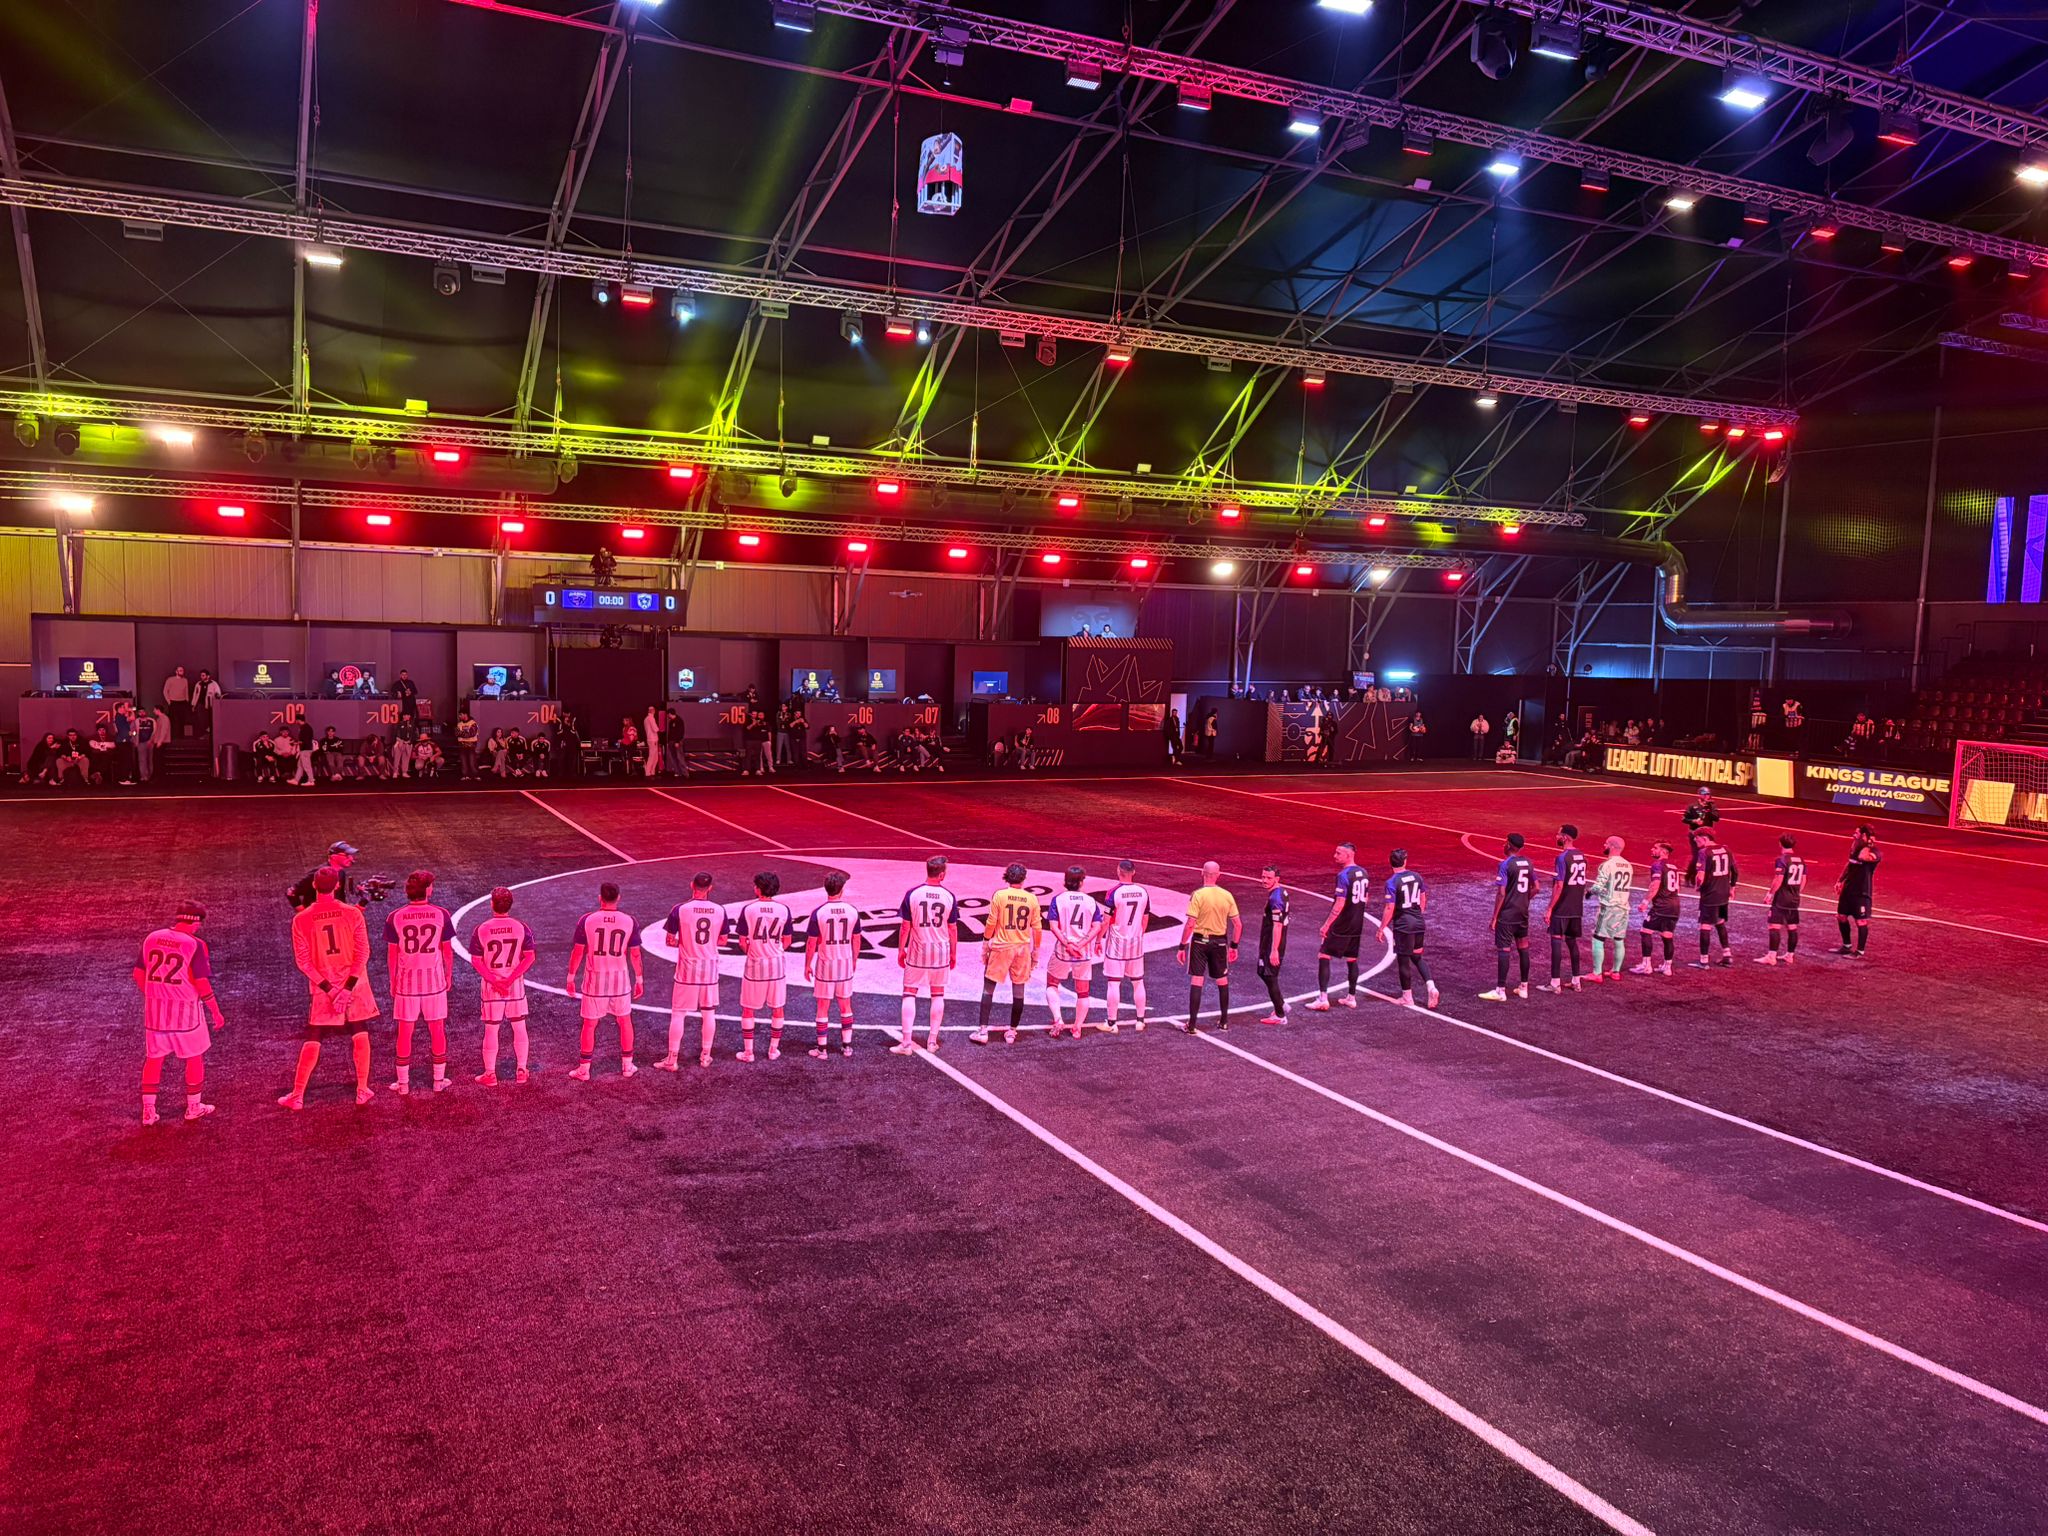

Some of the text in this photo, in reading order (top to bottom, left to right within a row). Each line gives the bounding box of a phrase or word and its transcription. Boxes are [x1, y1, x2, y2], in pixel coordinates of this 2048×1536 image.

[545, 591, 556, 605] 0
[598, 595, 624, 606] 00:00
[665, 596, 675, 610] 0
[380, 703, 399, 724] 03
[541, 704, 557, 724] 04
[730, 706, 746, 724] 05
[858, 706, 873, 724] 06
[924, 706, 939, 724] 07
[1047, 707, 1060, 724] 08
[1606, 748, 1649, 774] LEAGUE
[1806, 765, 1950, 792] KINGS LEAGUE
[1826, 783, 1921, 801] LOTTOMATICA SPORT
[1860, 798, 1887, 808] ITALY
[1568, 862, 1586, 886] 23
[1712, 854, 1729, 877] 11
[1787, 864, 1804, 885] 21
[1517, 869, 1529, 893] 5
[1614, 871, 1631, 892] 22
[1401, 882, 1421, 909] 14
[919, 901, 945, 928] 13
[1005, 903, 1030, 931] 18
[1070, 903, 1084, 930] 4
[1126, 901, 1139, 926] 7
[322, 924, 341, 955] 1
[402, 923, 437, 954] 82
[593, 927, 626, 957] 10
[695, 917, 711, 945] 8
[753, 916, 782, 944] 44
[825, 918, 850, 945] 11
[486, 938, 518, 969] 27
[147, 949, 185, 985] 22
